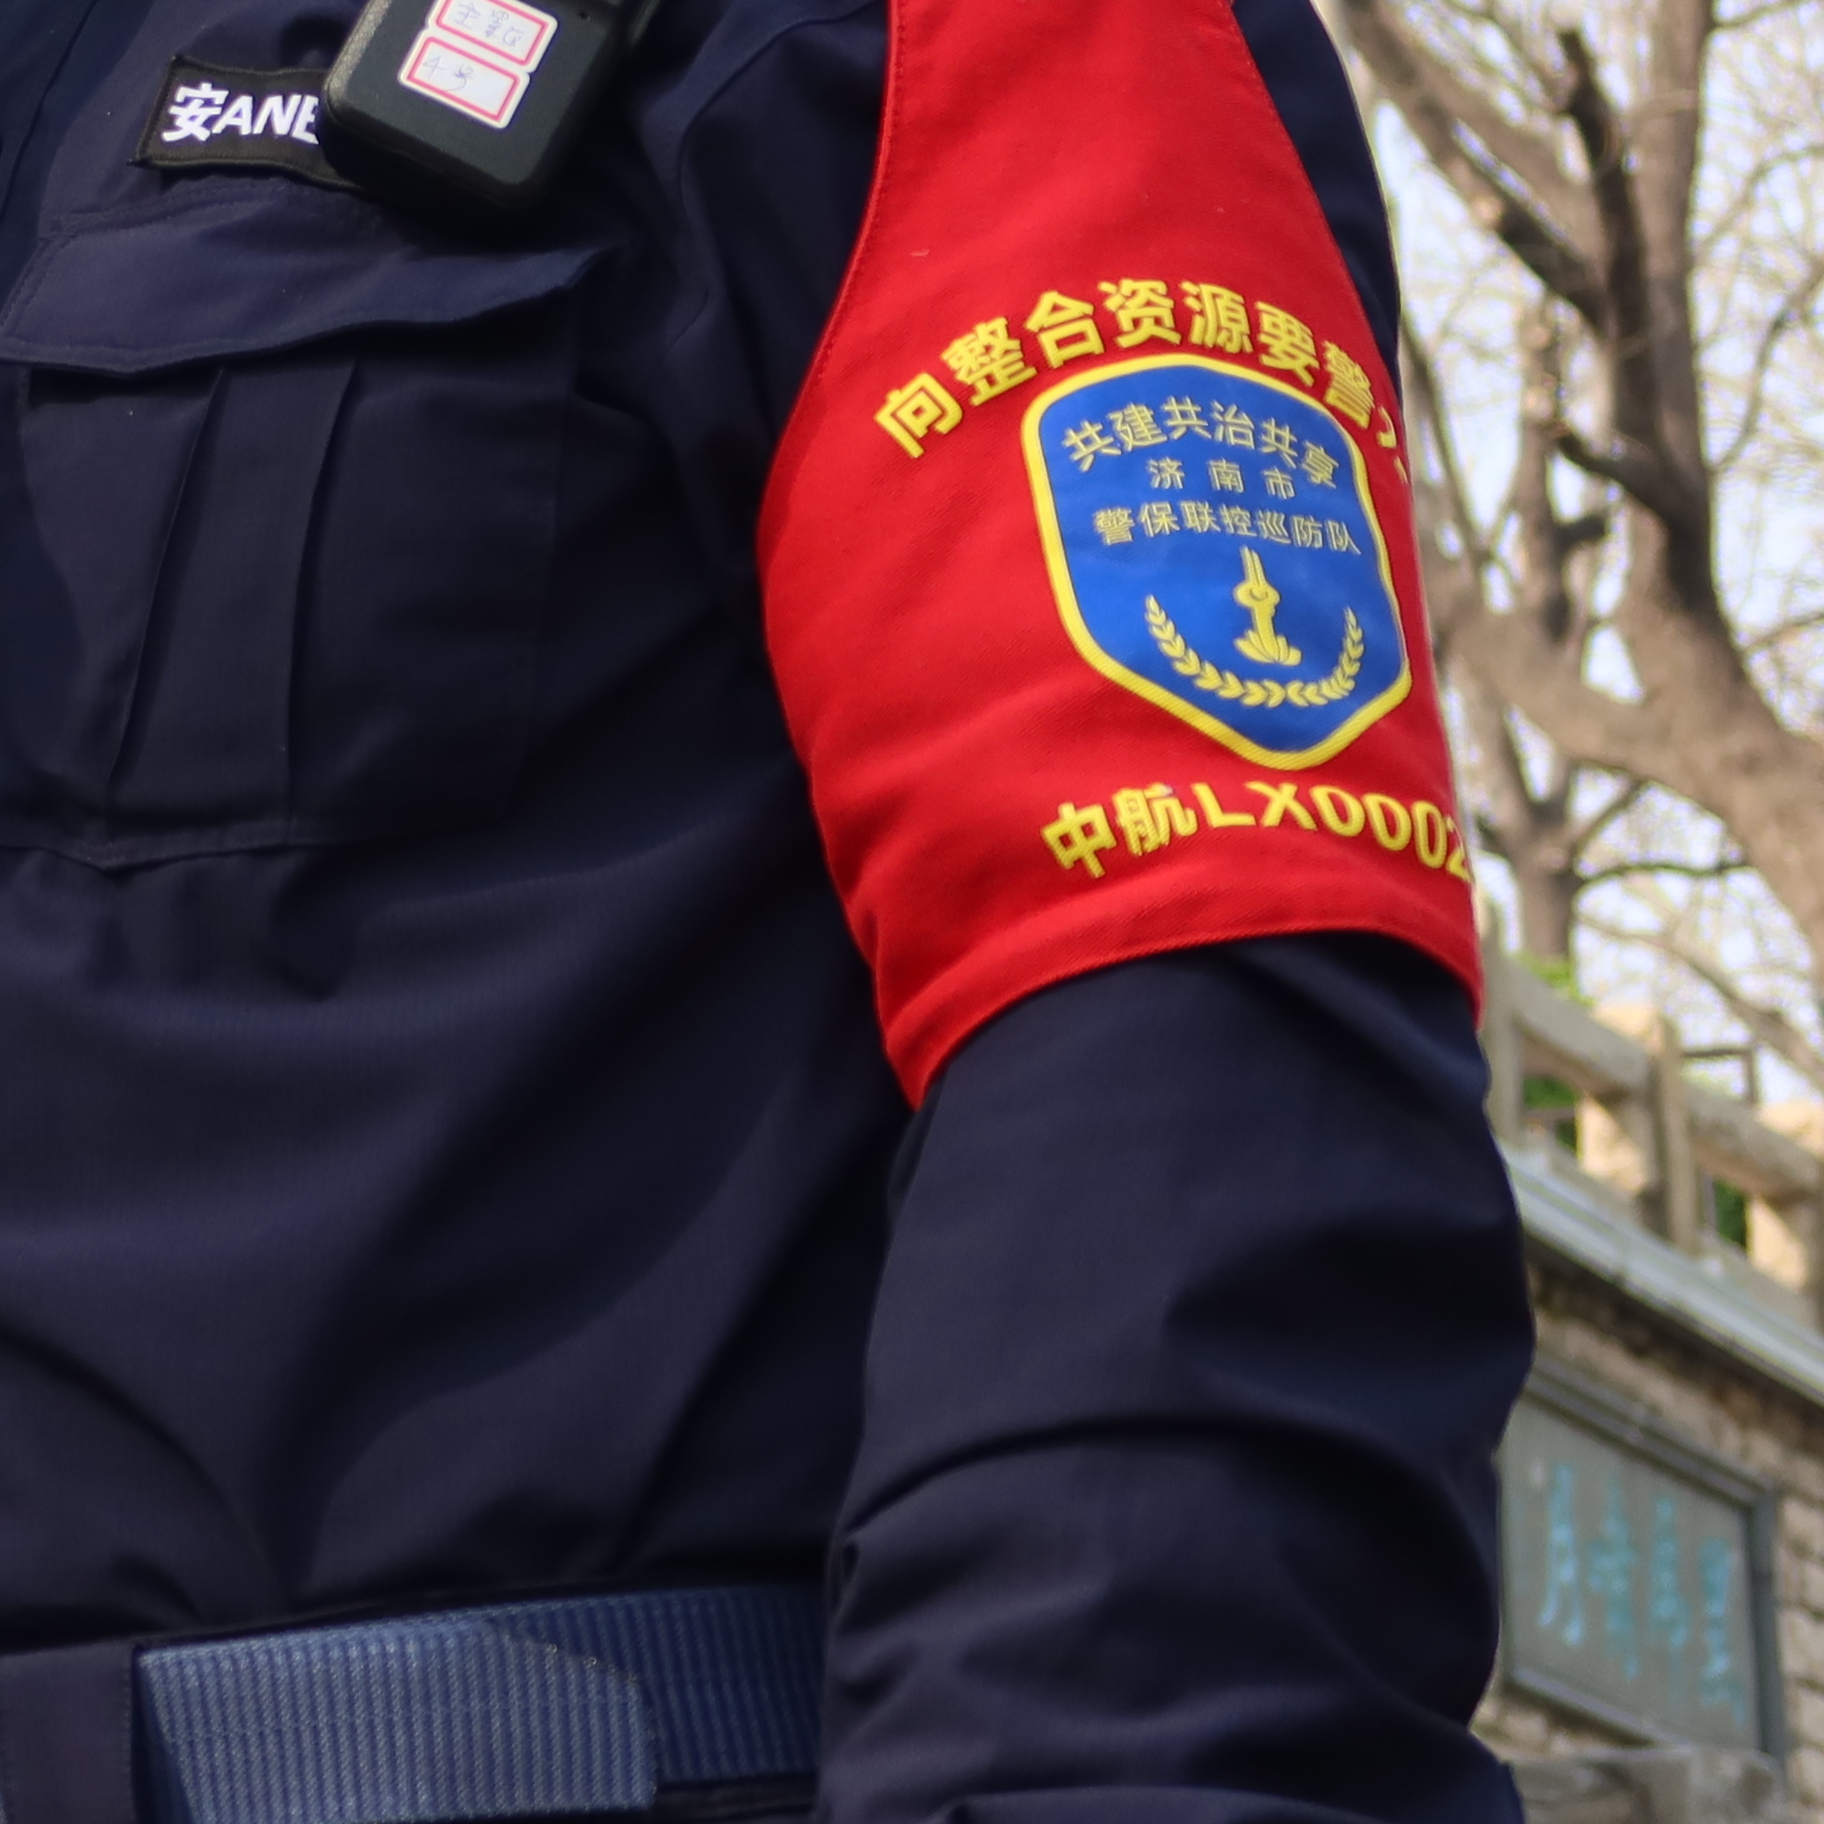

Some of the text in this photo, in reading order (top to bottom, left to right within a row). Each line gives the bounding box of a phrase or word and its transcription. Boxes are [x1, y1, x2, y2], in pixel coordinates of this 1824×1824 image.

[1062, 395, 1340, 489] 共建共治共享
[1093, 499, 1362, 556] 警保联控巡防队
